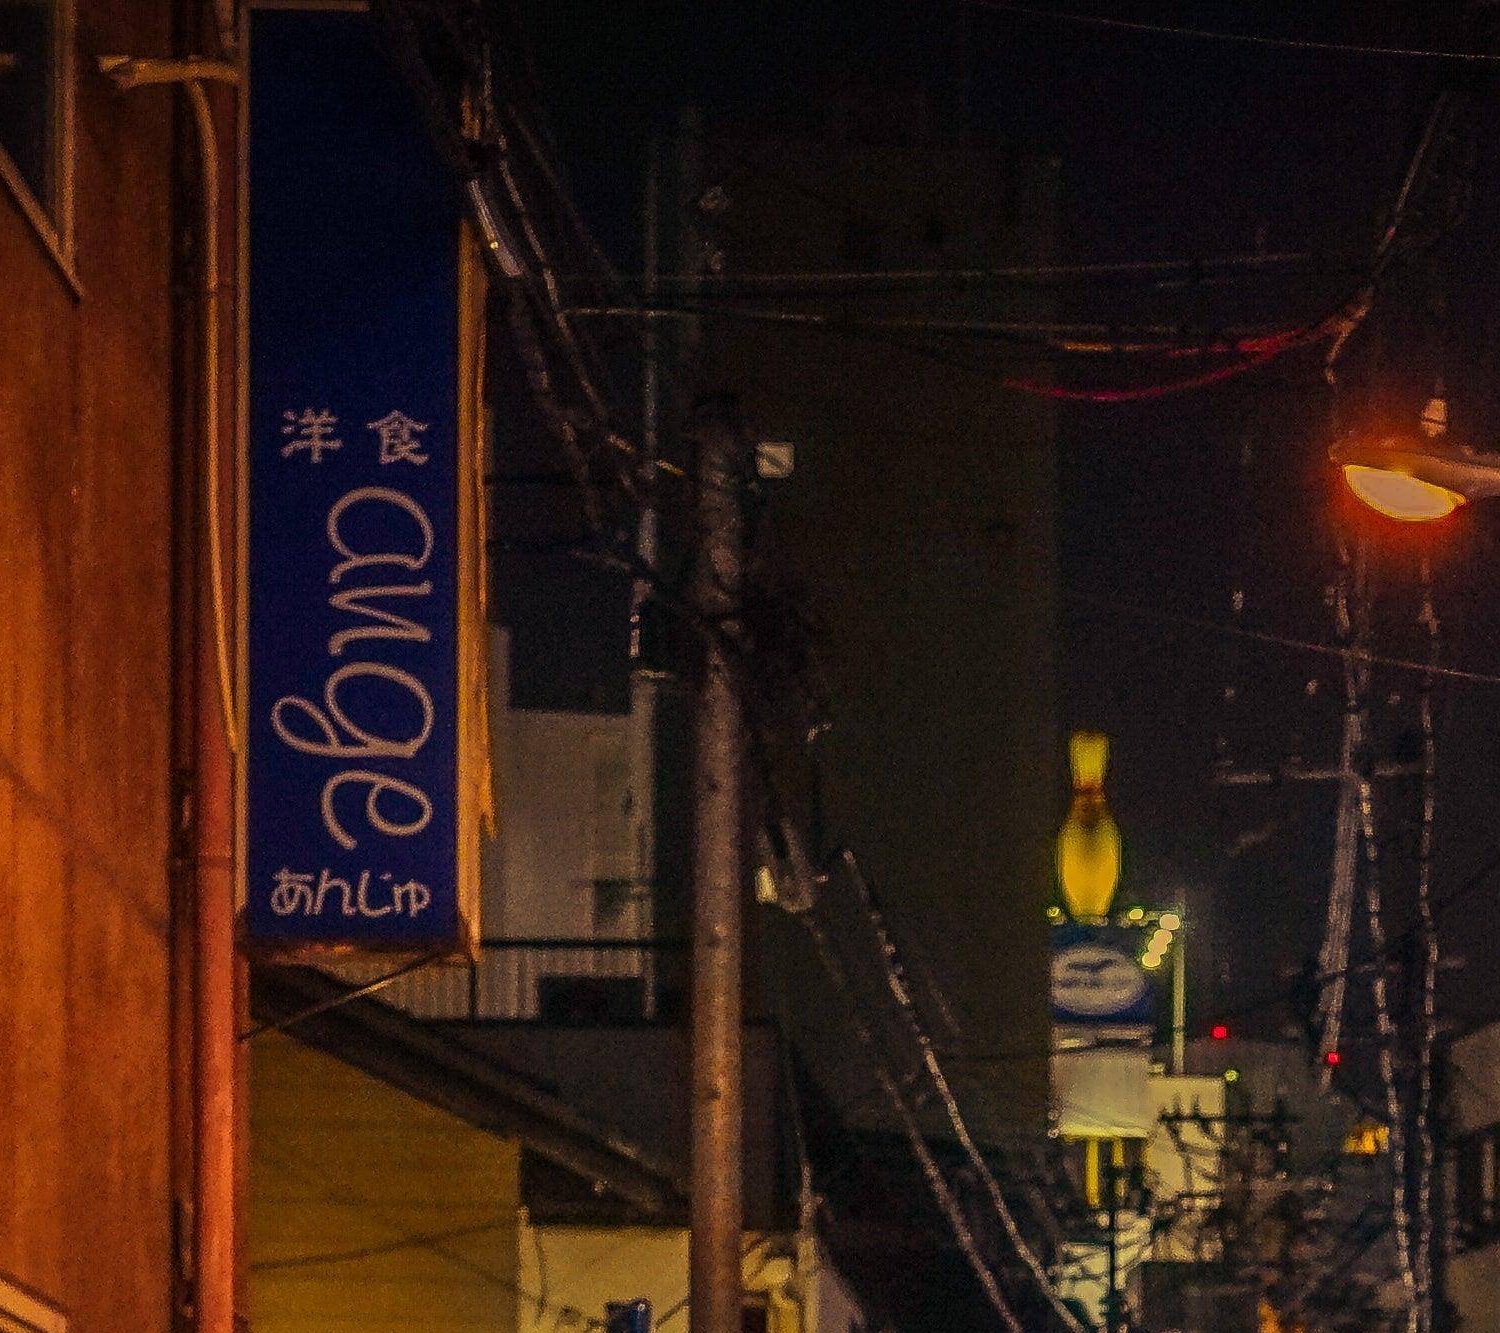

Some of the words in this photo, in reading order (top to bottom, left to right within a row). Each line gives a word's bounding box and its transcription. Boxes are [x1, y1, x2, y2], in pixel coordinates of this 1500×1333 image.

[278, 407, 431, 466] 洋食
[270, 485, 435, 851] ange
[270, 865, 433, 918] あんじゅ
